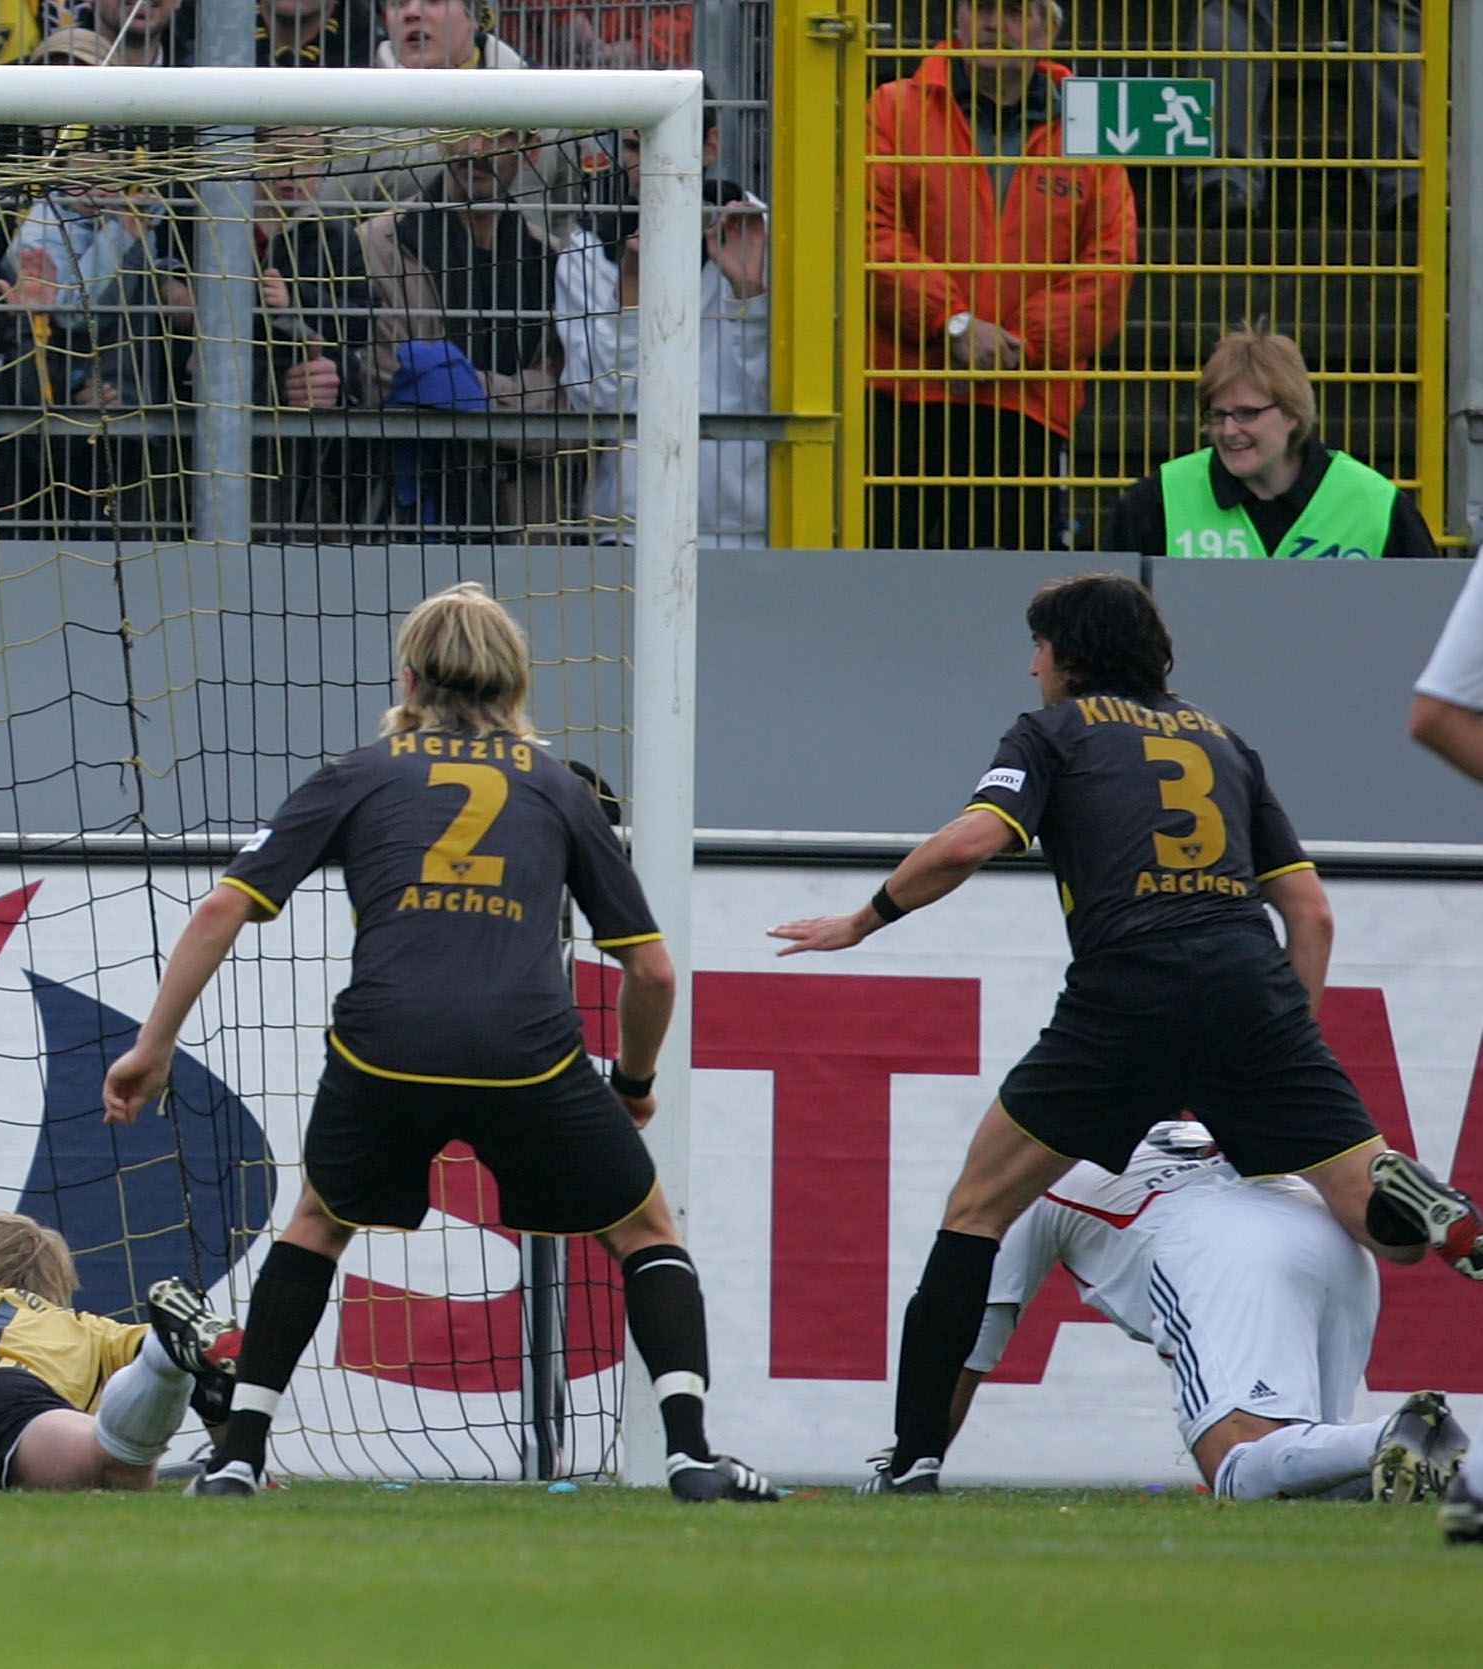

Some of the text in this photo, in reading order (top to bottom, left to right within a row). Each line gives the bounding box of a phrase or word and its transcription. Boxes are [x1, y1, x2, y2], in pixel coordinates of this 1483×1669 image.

[1176, 529, 1248, 558] 195
[391, 735, 532, 772] Herzig
[1143, 735, 1226, 869] 3
[421, 763, 509, 886] 2
[1135, 871, 1248, 898] Aachen
[398, 886, 523, 921] Aachen
